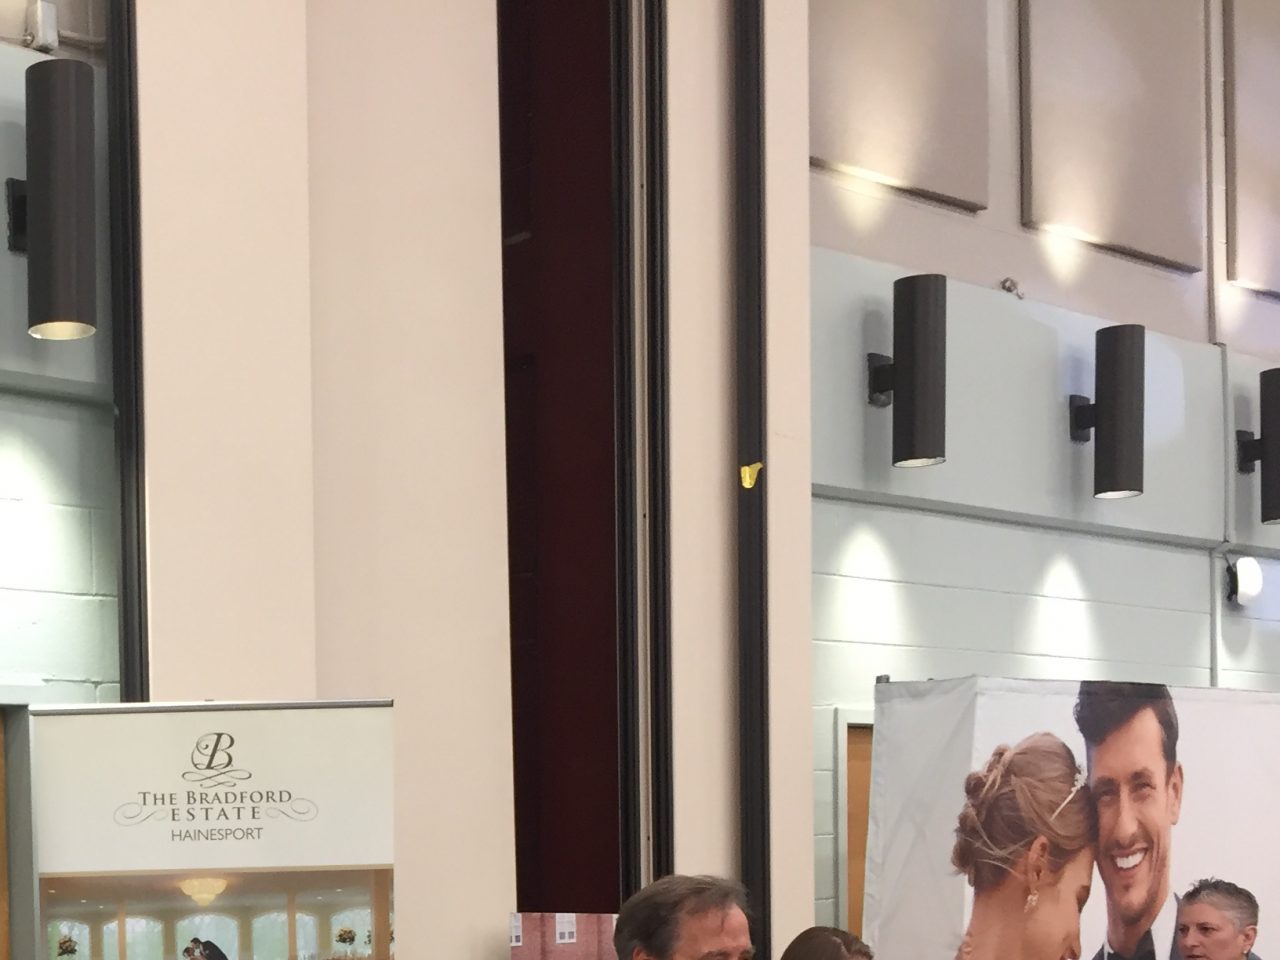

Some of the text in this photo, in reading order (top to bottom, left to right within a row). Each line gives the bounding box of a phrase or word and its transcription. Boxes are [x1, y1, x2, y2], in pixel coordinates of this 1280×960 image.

[138, 790, 292, 806] THE BRADFORD
[171, 806, 261, 821] ESTATE
[171, 827, 263, 841] HAINESPORT
